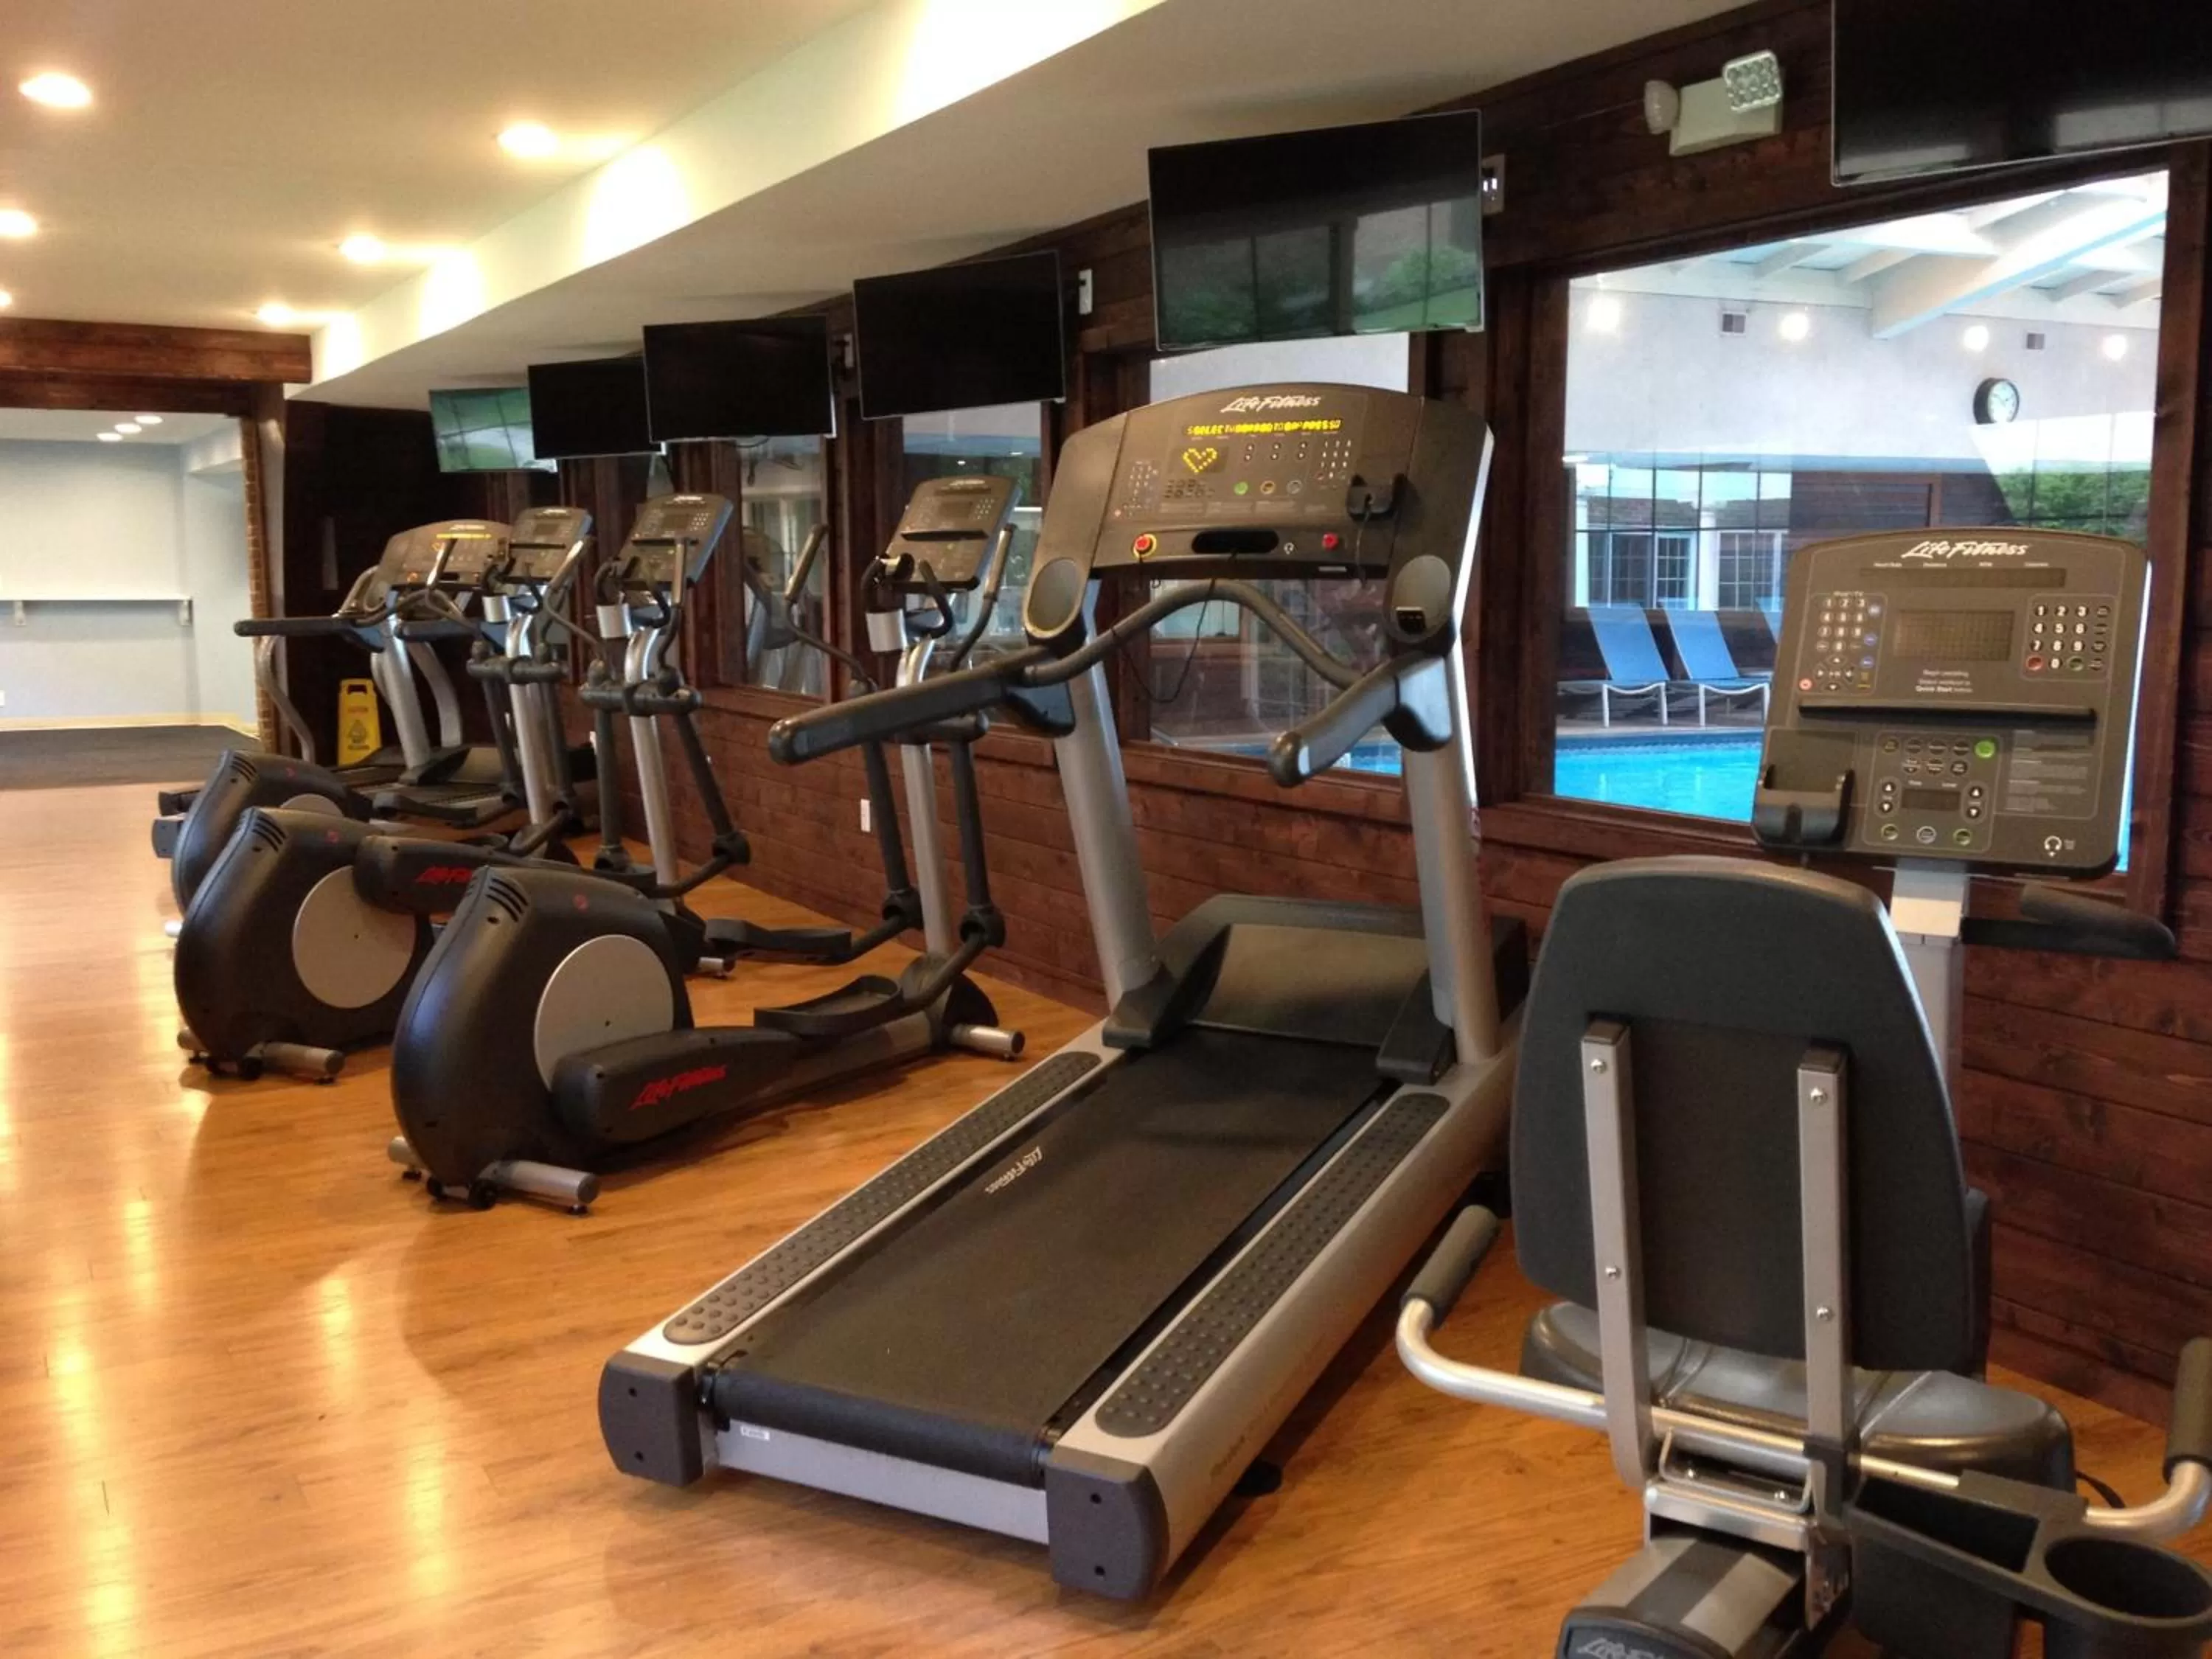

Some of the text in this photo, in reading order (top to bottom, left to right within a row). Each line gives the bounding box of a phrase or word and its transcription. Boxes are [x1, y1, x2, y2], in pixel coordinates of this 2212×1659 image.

[1901, 541, 2029, 558] Life Fitness
[2037, 605, 2087, 616] 1 2 3
